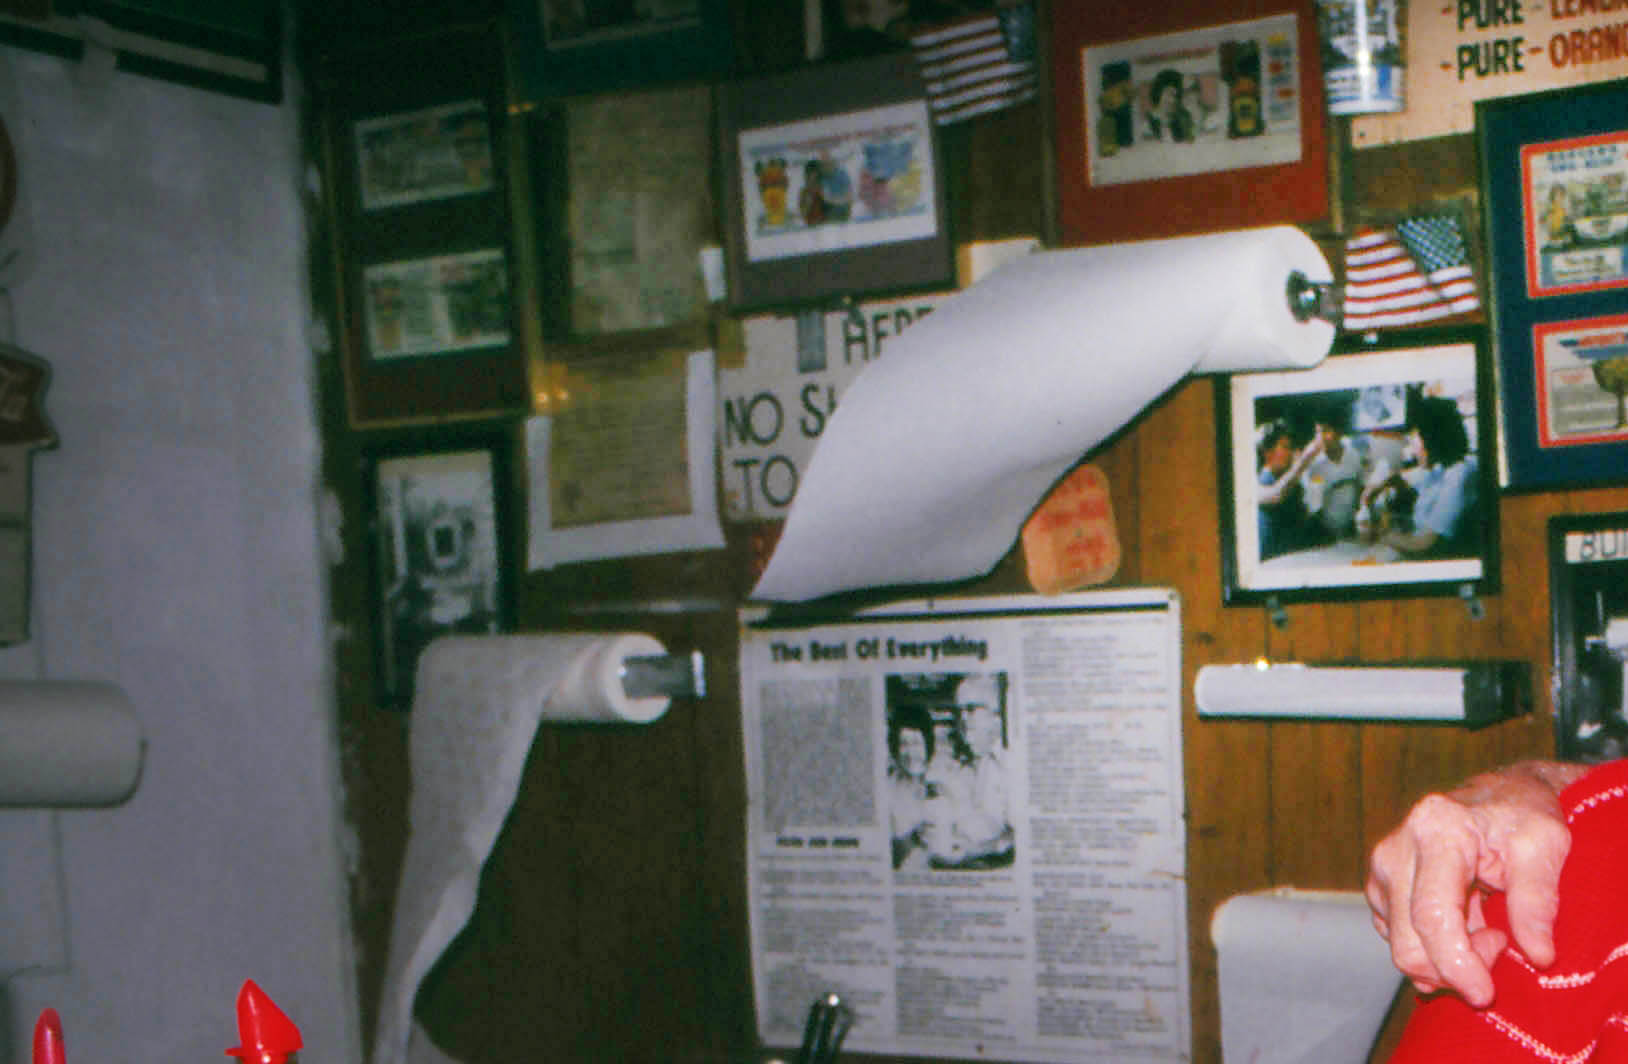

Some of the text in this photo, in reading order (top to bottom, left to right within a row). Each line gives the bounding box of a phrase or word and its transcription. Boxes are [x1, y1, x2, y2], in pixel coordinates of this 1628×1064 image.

[723, 388, 784, 448] NO
[732, 454, 799, 513] TO
[770, 634, 989, 664] The Best Of Everything
